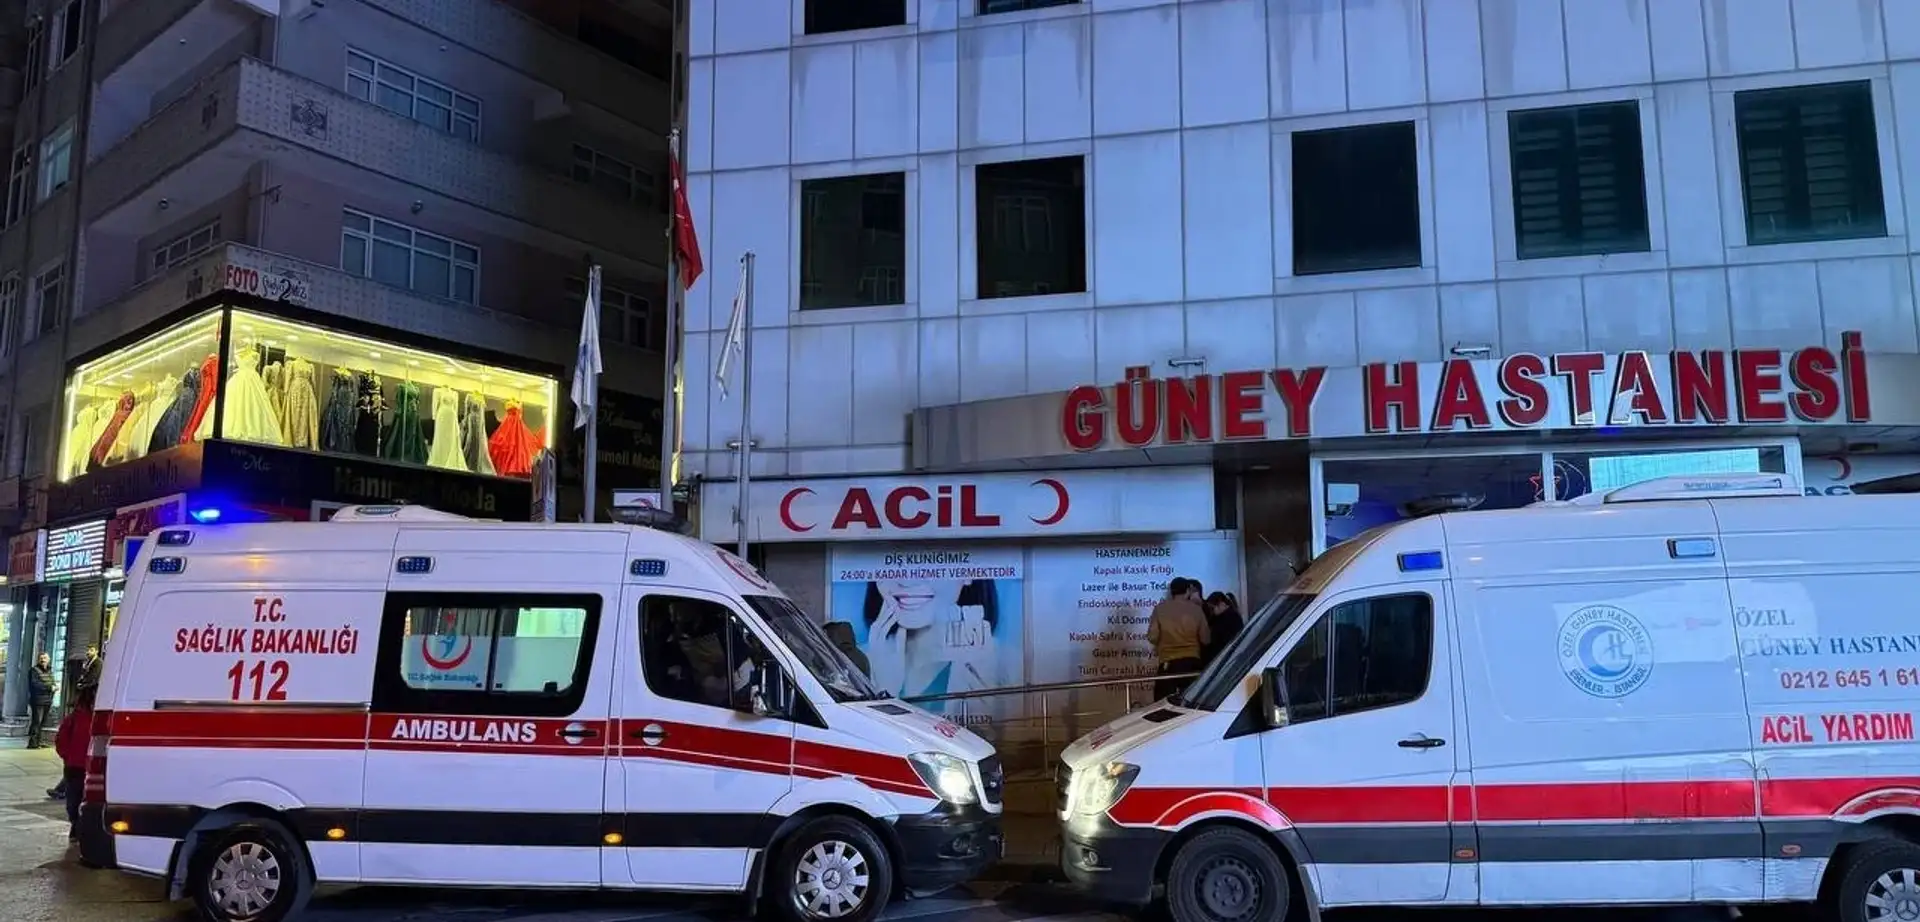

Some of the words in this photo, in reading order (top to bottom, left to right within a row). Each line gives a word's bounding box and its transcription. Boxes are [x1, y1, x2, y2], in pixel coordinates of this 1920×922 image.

[226, 265, 259, 292] FOTO
[1062, 365, 1328, 451] GÜNEY
[1363, 331, 1872, 433] HASTANESİ
[885, 551, 904, 566] DİŞ
[875, 568, 908, 579] KADAR
[1082, 582, 1106, 592] Lazer
[1122, 582, 1148, 592] Basur
[253, 598, 286, 623] T.C.
[1078, 599, 1131, 611] Endoskopik
[1122, 615, 1151, 625] Dönm
[1736, 607, 1795, 628] ÖZEL
[175, 623, 247, 653] SAĞLIK
[251, 624, 359, 655] BAKANLIĞI
[1099, 632, 1124, 642] Safra
[1741, 634, 1822, 657] GÜNEY
[1830, 635, 1920, 655] HASTAN
[228, 660, 290, 701] 112
[1780, 670, 1829, 689] 0212
[1835, 669, 1872, 688] 645
[391, 718, 537, 744] AMBULANS
[1821, 712, 1914, 743] YARDIM
